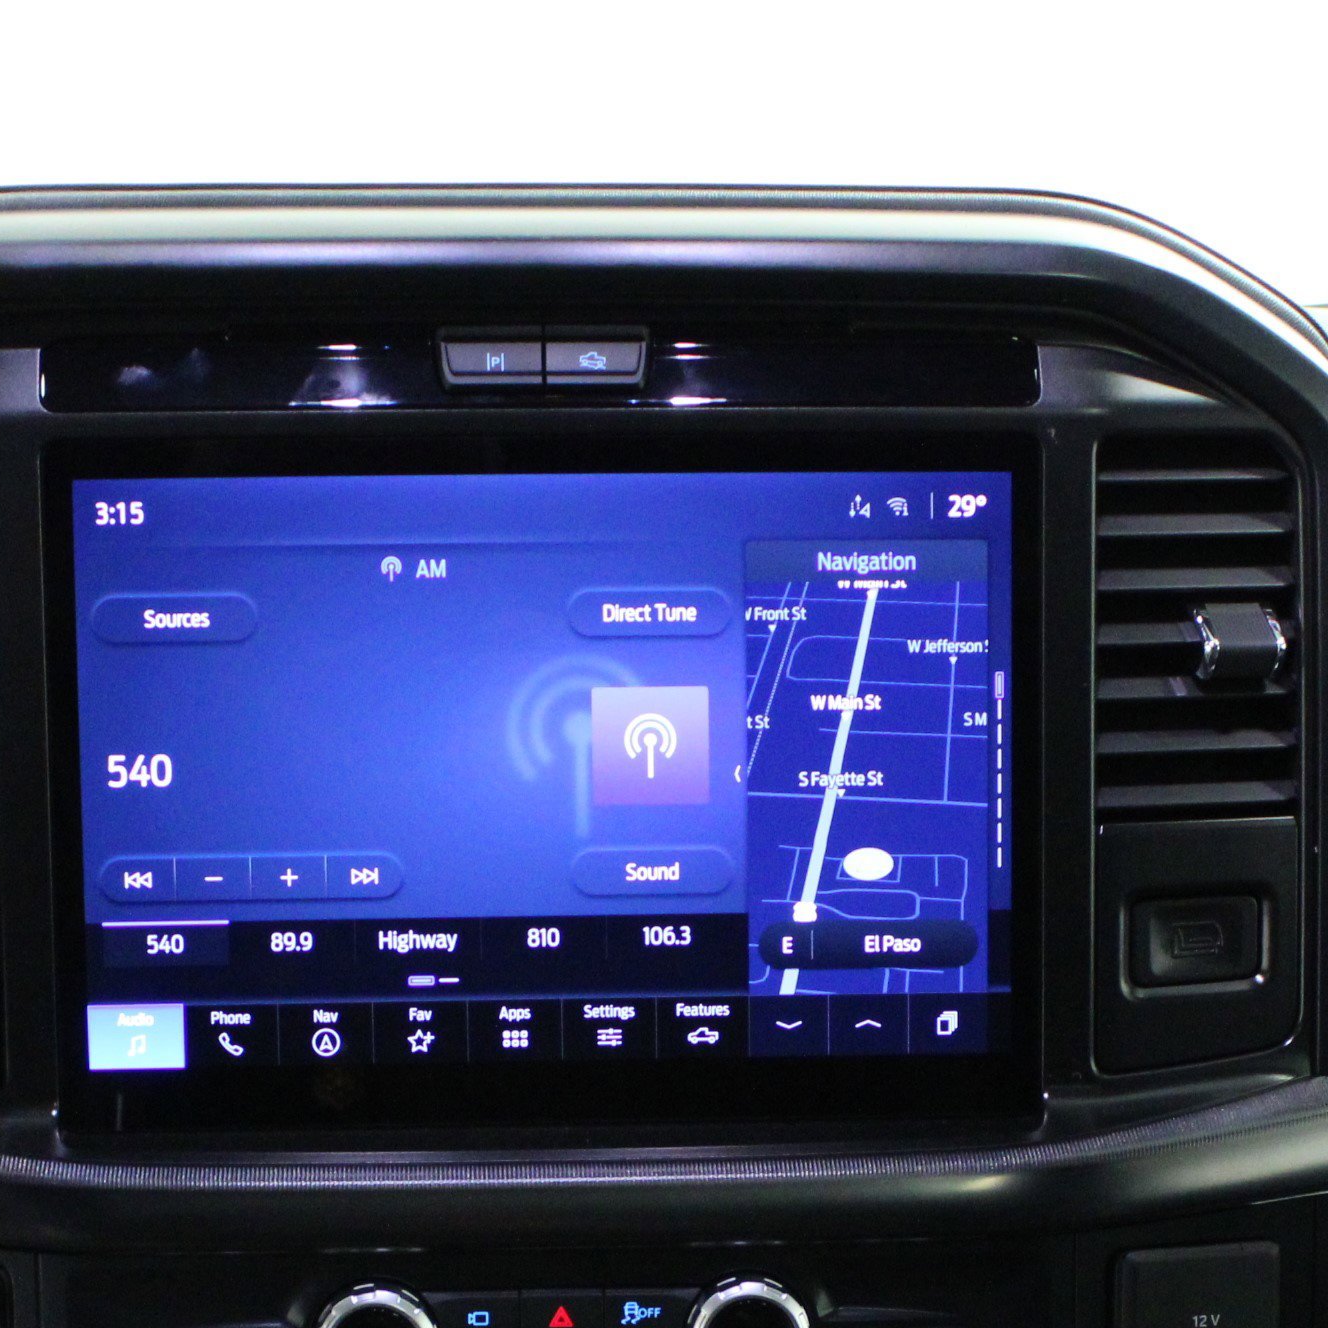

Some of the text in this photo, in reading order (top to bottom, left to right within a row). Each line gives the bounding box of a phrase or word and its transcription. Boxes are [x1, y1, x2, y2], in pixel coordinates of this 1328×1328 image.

[95, 501, 144, 525] 3:15
[415, 559, 447, 579] AM
[817, 552, 916, 575] Navigation
[143, 609, 210, 629] Sources
[602, 603, 697, 623] Direct Tune
[753, 606, 790, 621] Front
[791, 605, 807, 621] St
[907, 639, 921, 653] W
[923, 638, 983, 654] Jefferson
[810, 693, 882, 711] W Main St
[754, 714, 770, 729] St
[963, 711, 973, 727] S
[107, 753, 173, 788] 540
[798, 770, 883, 789] S Fayette St
[625, 863, 680, 882] Sound
[146, 933, 184, 955] 540
[270, 931, 313, 952] 89.9
[378, 930, 458, 953] Highway
[527, 928, 560, 948] 810
[642, 926, 691, 946] 106.3
[781, 936, 793, 954] E
[864, 935, 922, 954] El Paso
[117, 1012, 155, 1027] Audio
[210, 1009, 251, 1026] Phone
[313, 1008, 338, 1024] Nav
[408, 1007, 432, 1023] Fav
[499, 1006, 531, 1023] Apps
[583, 1004, 636, 1021] Settings
[675, 1003, 730, 1018] Features
[639, 1306, 661, 1318] OFF
